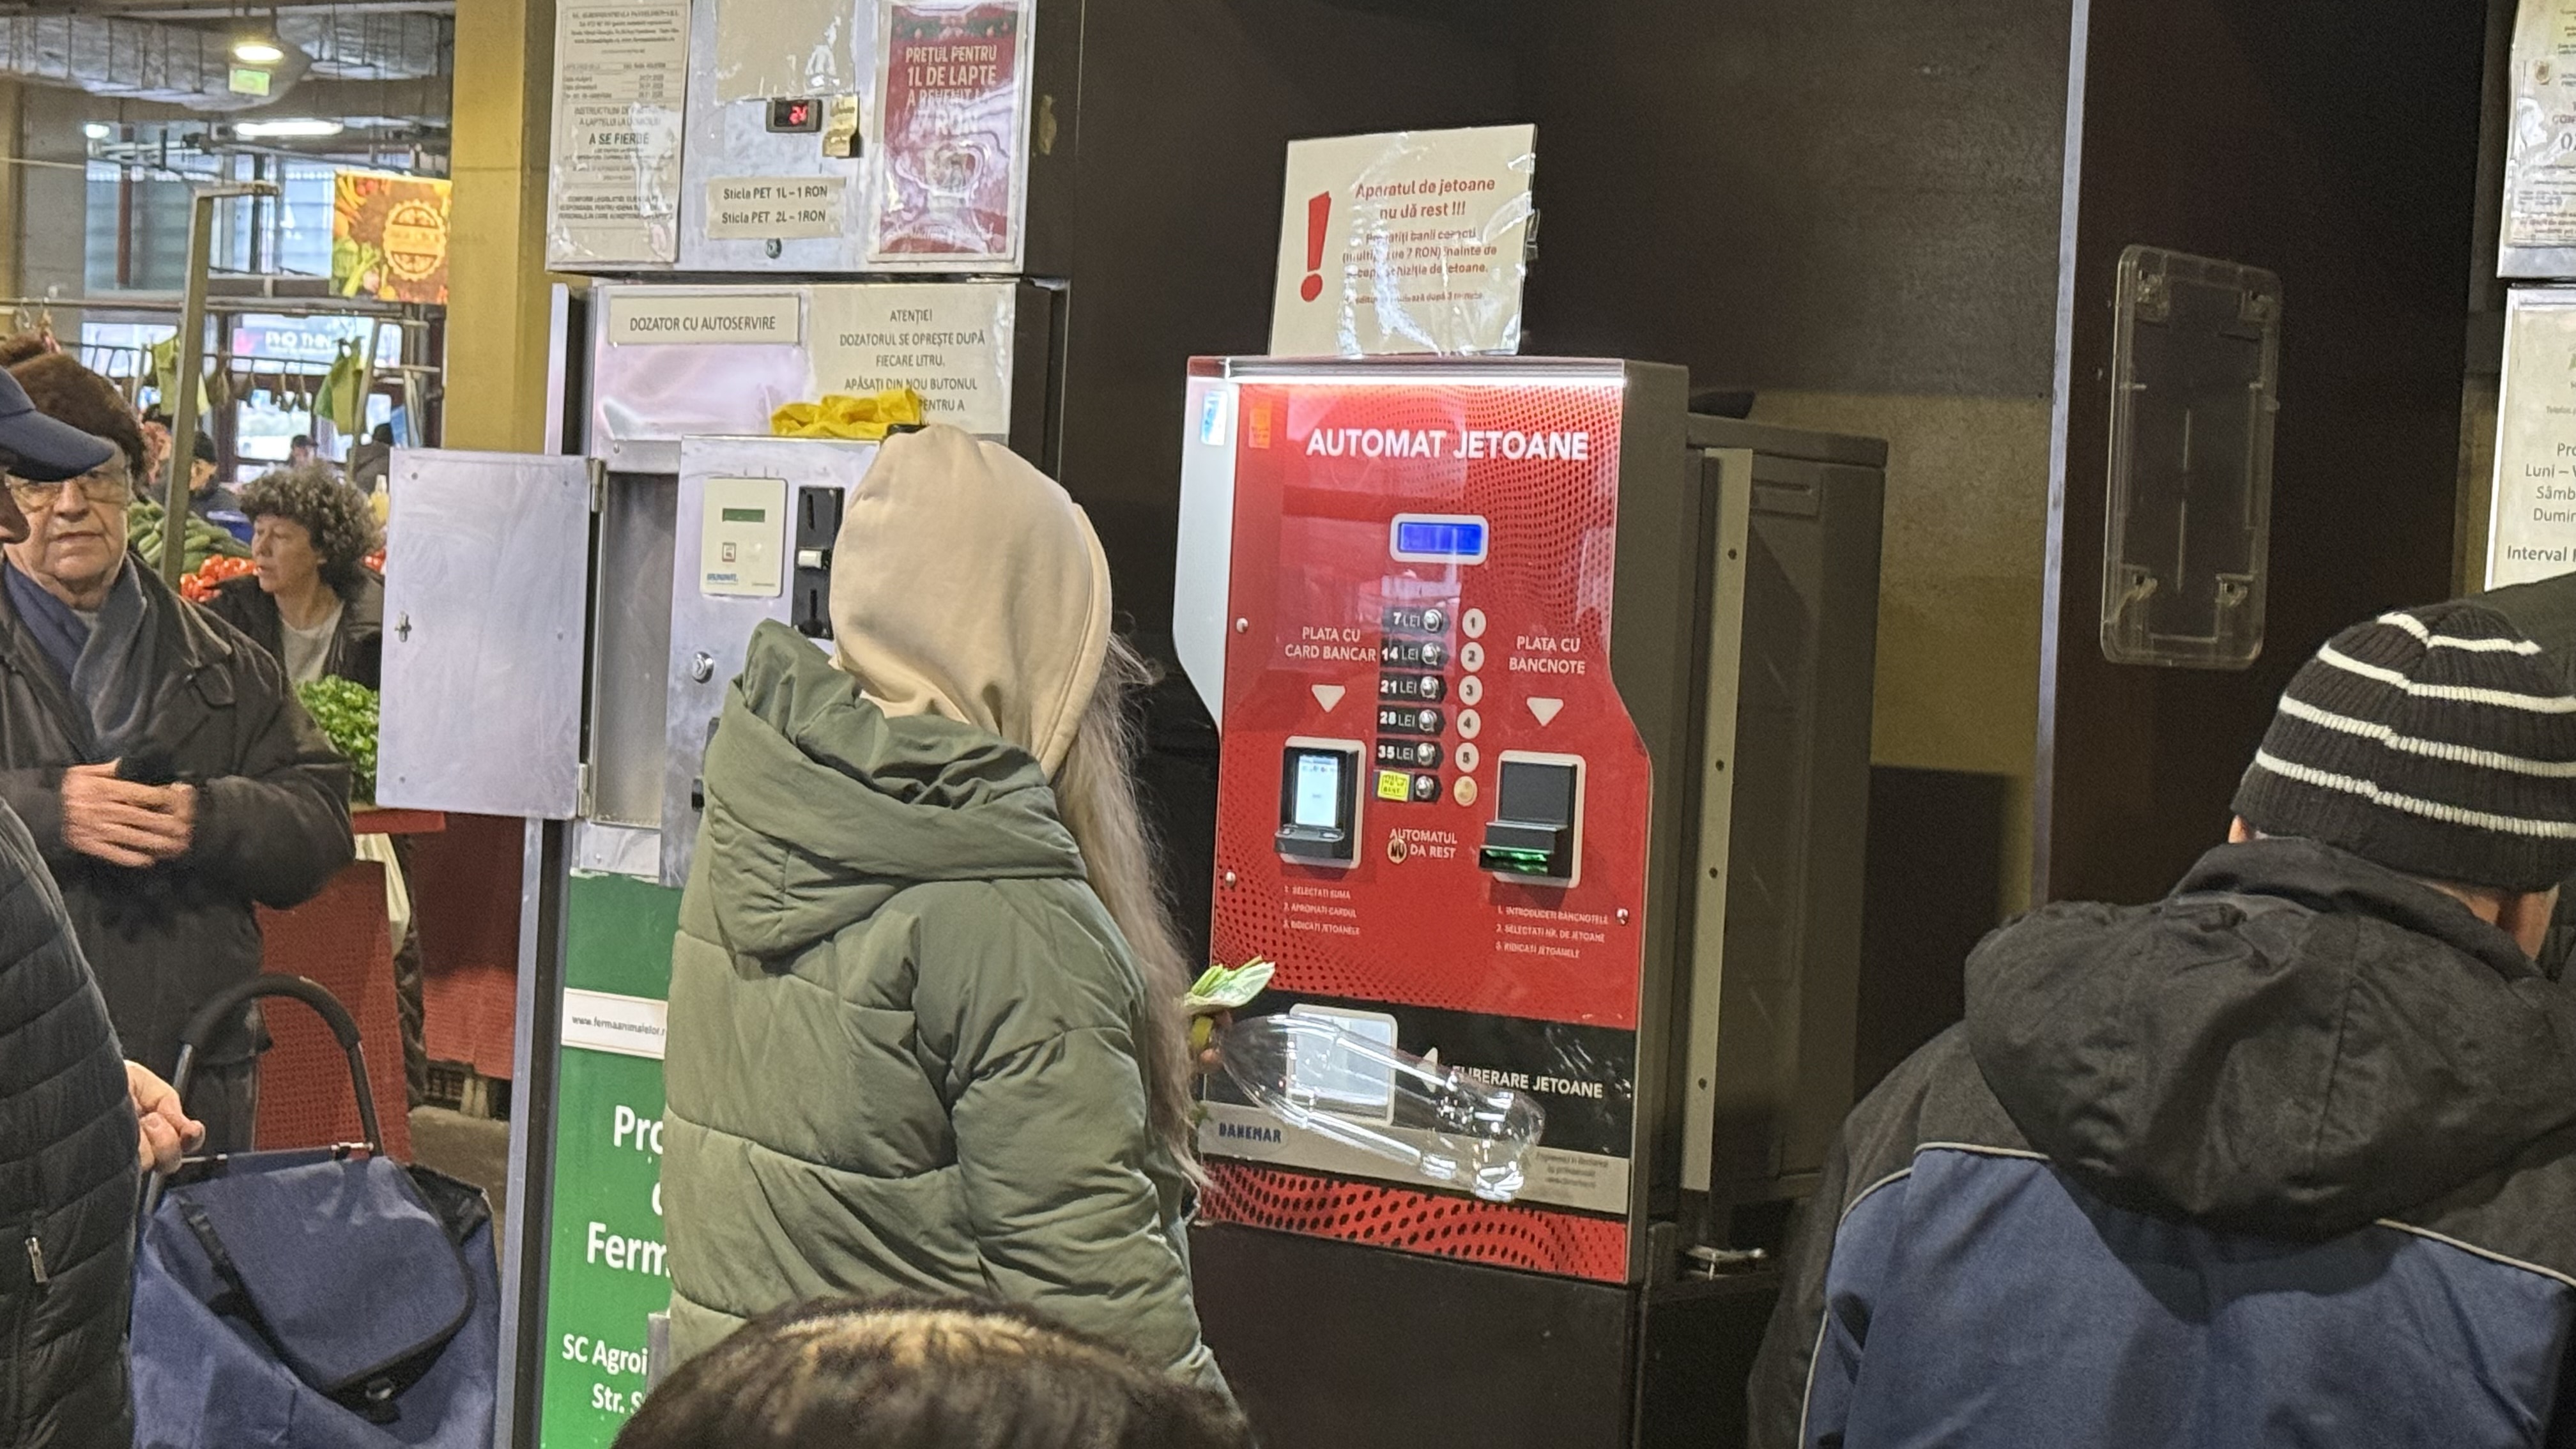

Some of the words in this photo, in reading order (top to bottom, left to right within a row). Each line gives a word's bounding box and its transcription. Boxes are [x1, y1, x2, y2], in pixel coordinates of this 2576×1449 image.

[951, 45, 997, 62] PENTRU
[907, 66, 922, 86] 1L
[926, 66, 946, 86] DE
[949, 65, 997, 86] LAPTE
[906, 89, 916, 107] A
[588, 133, 596, 145] A
[599, 133, 612, 145] SE
[723, 187, 751, 200] Sticla
[753, 187, 772, 199] PET
[776, 187, 787, 199] 1L
[805, 185, 828, 197] RON
[1418, 180, 1436, 194] de
[1439, 178, 1495, 197] jetoane
[722, 211, 749, 224] Sticla
[751, 211, 770, 224] PET
[776, 211, 787, 223] 2L
[1379, 208, 1397, 220] nu
[1400, 203, 1417, 218] dă
[1420, 203, 1448, 217] rest
[1452, 201, 1466, 216] !!!
[1414, 247, 1441, 259] RON)
[1483, 244, 1498, 256] de
[630, 317, 680, 332] DOZATOR
[683, 316, 699, 331] CU
[701, 316, 776, 331] AUTOSERVIRE
[840, 334, 897, 347] DOZATORUL
[898, 334, 910, 346] SE
[912, 333, 954, 348] OPREȘTE
[956, 329, 986, 345] DUPĂ
[876, 355, 914, 367] FIECARE
[886, 378, 903, 391] DIN
[906, 378, 926, 390] NOU
[930, 378, 978, 391] BUTONUL
[918, 398, 955, 412] PENTRU
[957, 399, 965, 411] A
[1306, 429, 1446, 457] AUTOMAT
[1453, 431, 1589, 460] JETOANE
[2525, 463, 2555, 478] Luni
[2506, 545, 2567, 562] Interval
[1393, 612, 1402, 625] 7
[1403, 614, 1420, 627] LEI
[1470, 617, 1476, 629] 1
[1302, 626, 1339, 641] PLATA
[1342, 628, 1361, 642] CU
[1516, 635, 1557, 652] PLATA
[1561, 638, 1581, 653] CU
[1285, 643, 1319, 659] CARD
[1322, 645, 1376, 662] BANCAR
[1381, 647, 1399, 661] 14
[1402, 647, 1418, 661] LEI
[1468, 650, 1476, 663] 2
[1509, 657, 1585, 675] BANCNOTE
[1380, 680, 1397, 694] 21
[1400, 680, 1417, 694] LEI
[1466, 684, 1473, 696] 3
[1379, 711, 1397, 726] 28
[1398, 714, 1416, 728] LEI
[1463, 716, 1471, 730] 4
[1377, 745, 1395, 759] 35
[1397, 746, 1414, 762] LEI
[1462, 751, 1470, 764] 5
[1390, 828, 1458, 845] AUTOMATUL
[1410, 844, 1427, 857] DA
[1429, 845, 1457, 859] REST
[1560, 930, 1570, 939] DE
[1533, 1075, 1604, 1099] JETOANE
[586, 1221, 671, 1278] Ferm
[562, 1333, 588, 1363] SC
[592, 1340, 648, 1376] Agroi
[592, 1383, 625, 1414] Str.
